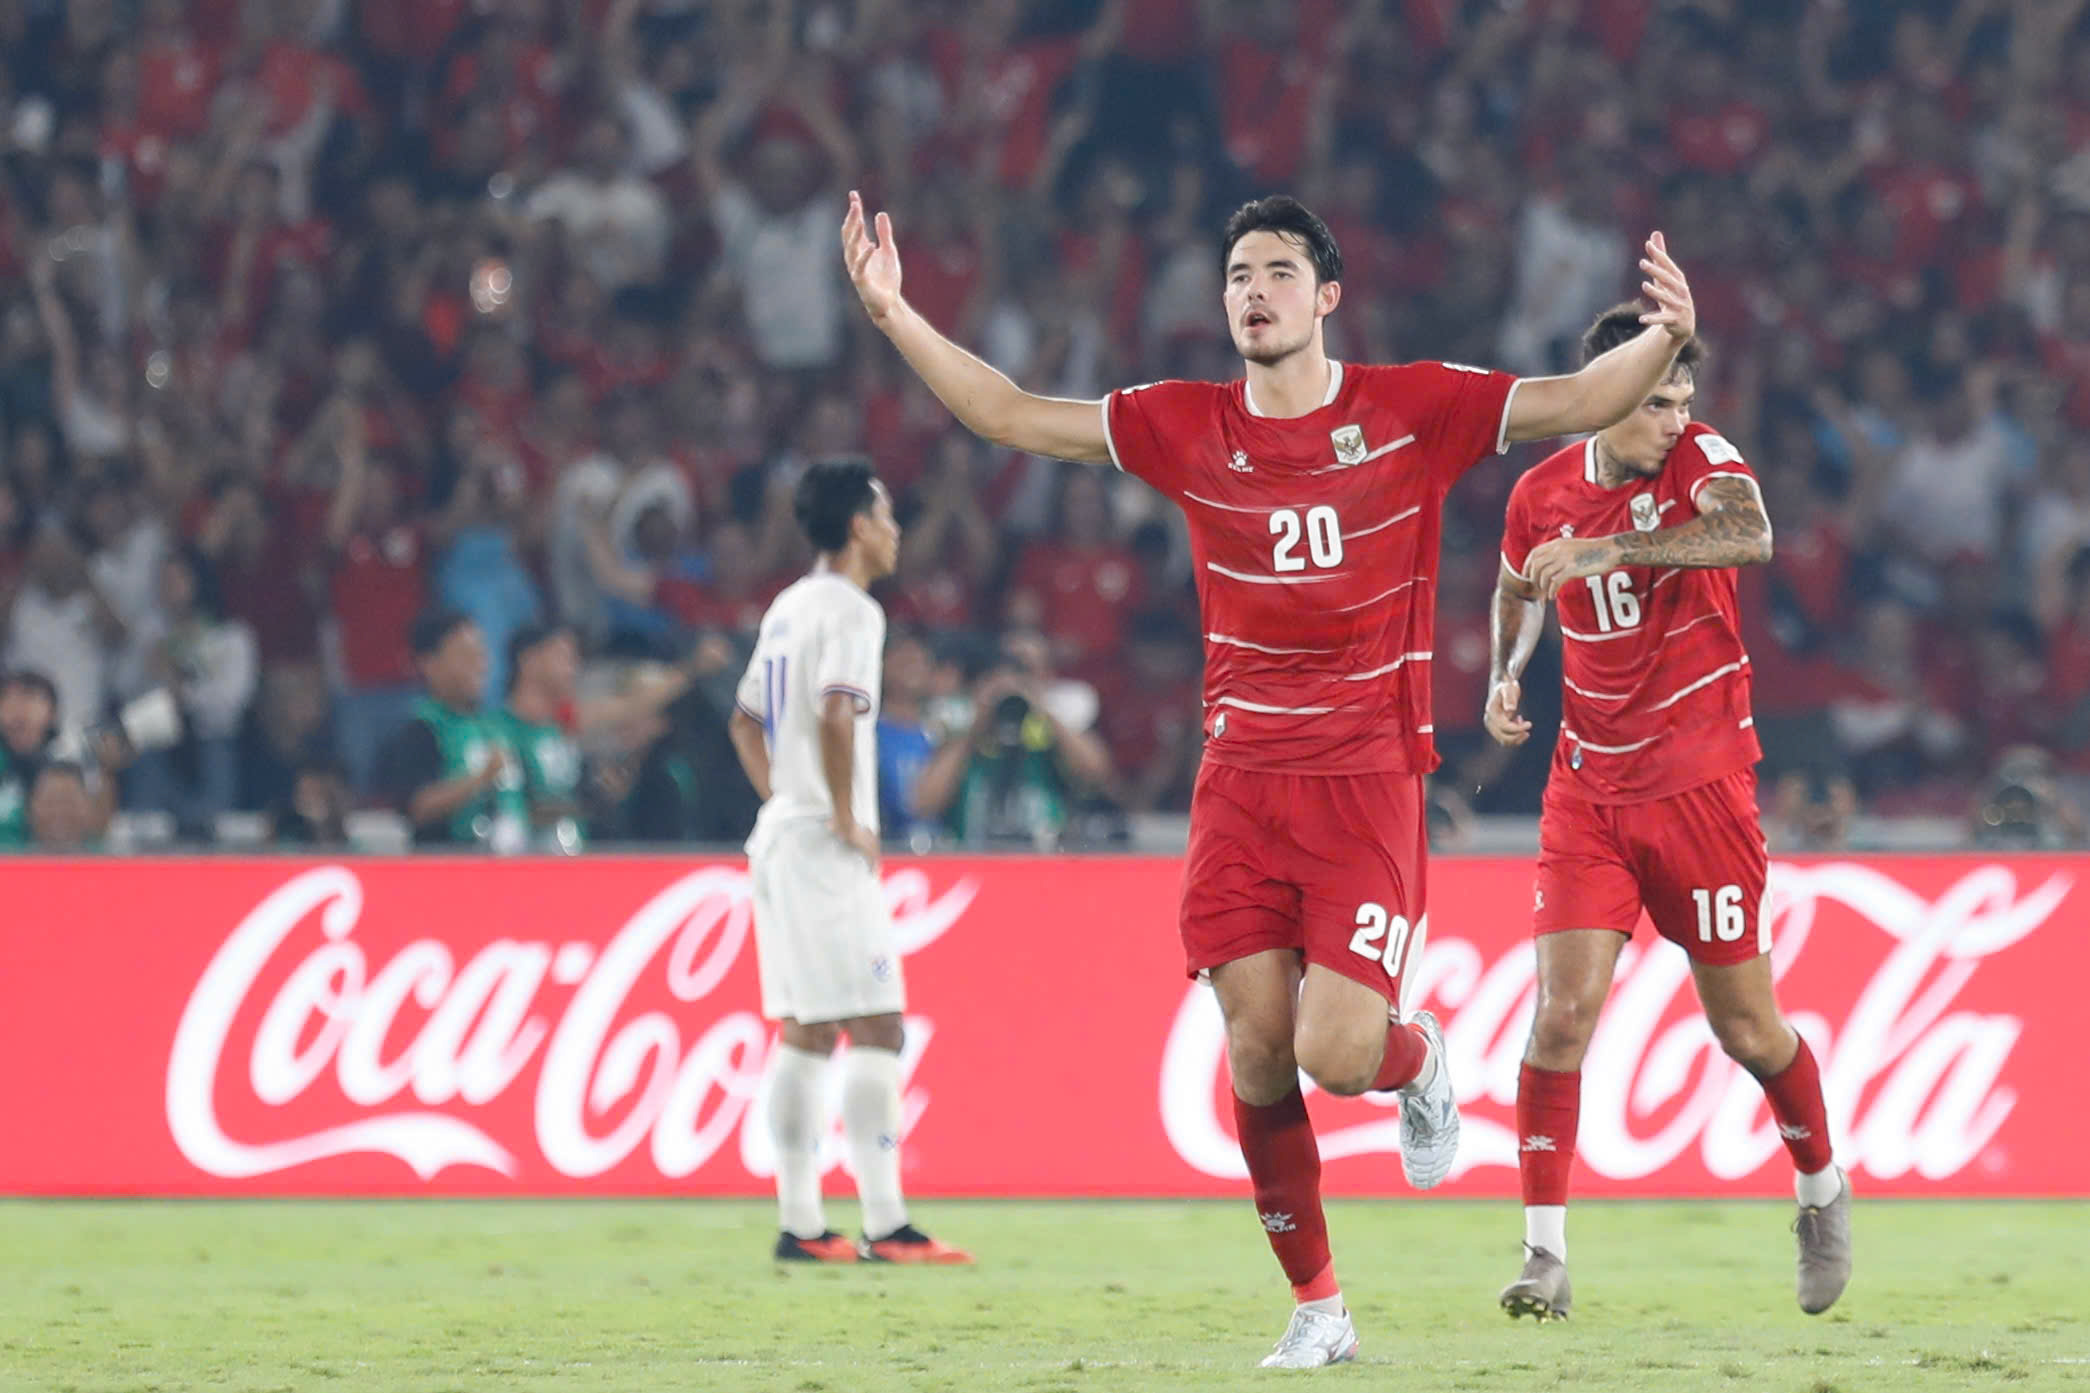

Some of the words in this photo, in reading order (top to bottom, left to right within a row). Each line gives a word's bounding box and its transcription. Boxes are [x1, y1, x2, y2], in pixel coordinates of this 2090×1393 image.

[1269, 505, 1344, 572] 20
[1586, 570, 1642, 632] 16
[1348, 902, 1409, 978] 20
[1692, 884, 1745, 942] 16
[166, 866, 980, 1180] Coca-Co
[1160, 861, 2074, 1180] Ca-Cola
